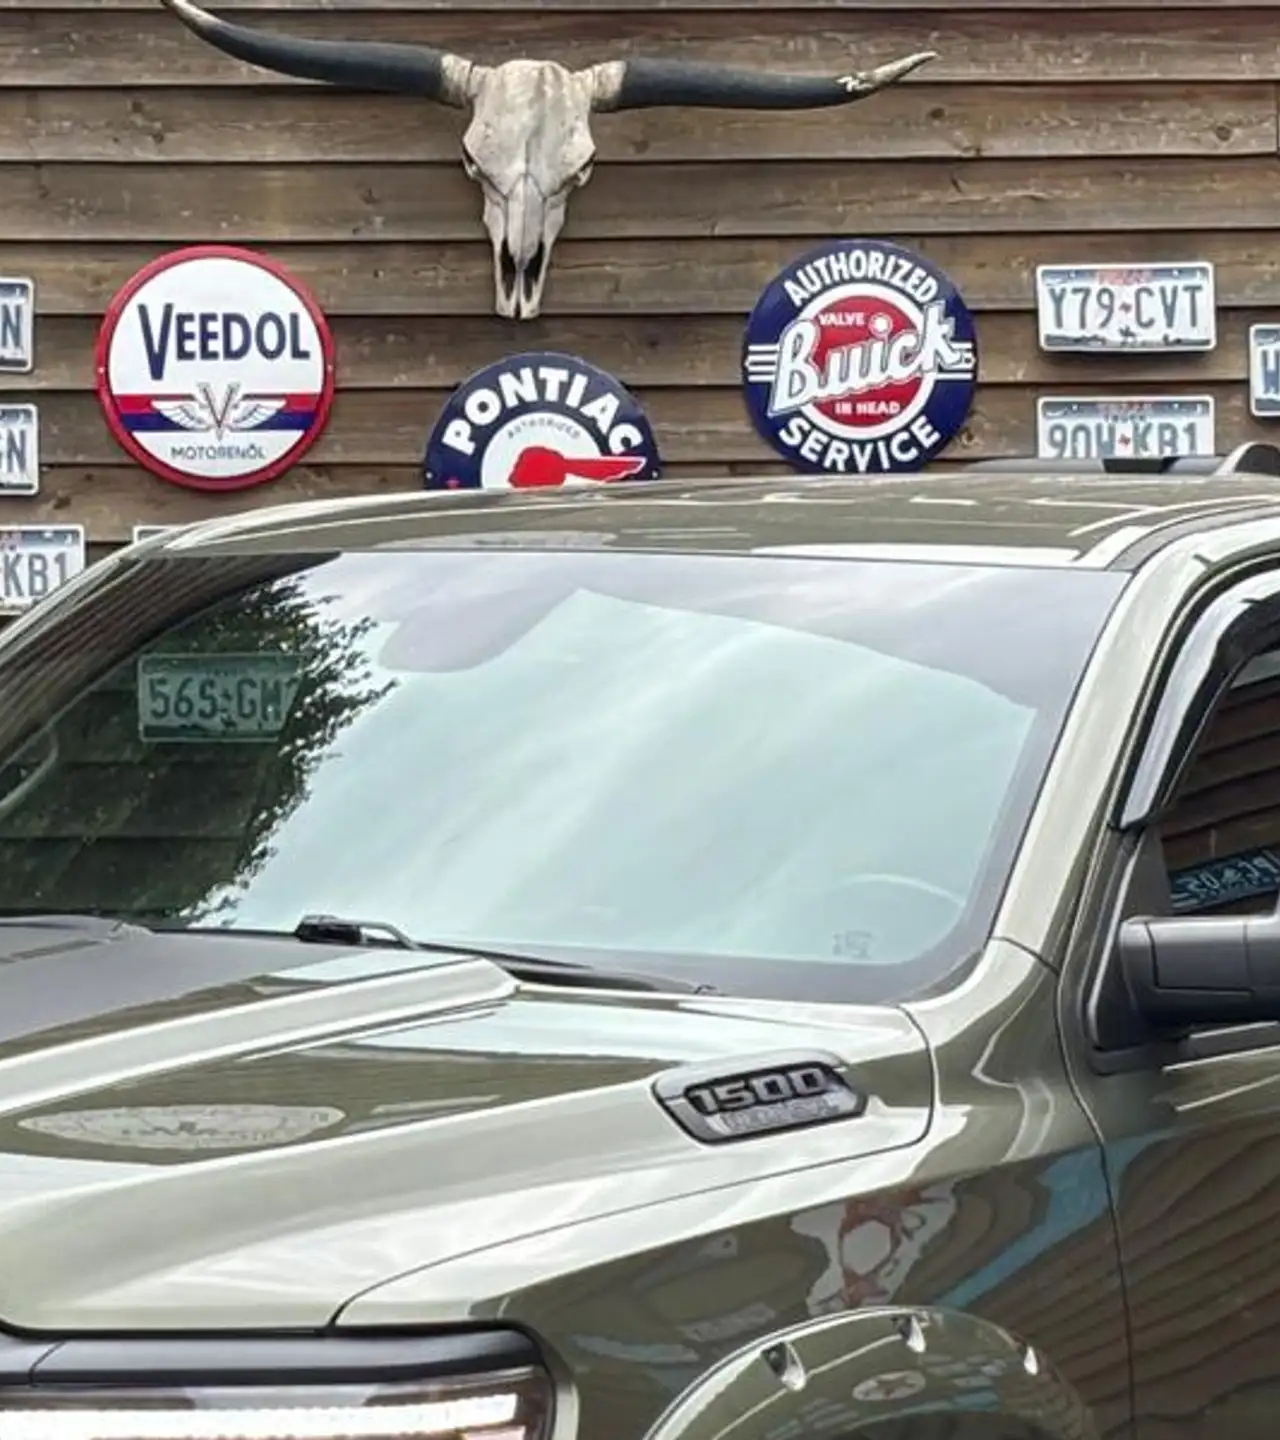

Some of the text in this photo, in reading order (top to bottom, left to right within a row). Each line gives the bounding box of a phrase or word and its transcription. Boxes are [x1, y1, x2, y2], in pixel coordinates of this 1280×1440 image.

[783, 249, 939, 307] AUTHORIZED
[819, 312, 866, 326] VALVE
[1135, 285, 1204, 328] CVT
[136, 302, 311, 382] VEEDOL
[769, 301, 961, 416] Buick
[441, 367, 644, 456] PONTIAC
[856, 402, 901, 415] HEAD
[170, 443, 267, 461] MOTORENÖL
[778, 416, 941, 472] SERVICE
[688, 1067, 830, 1114] 1500
